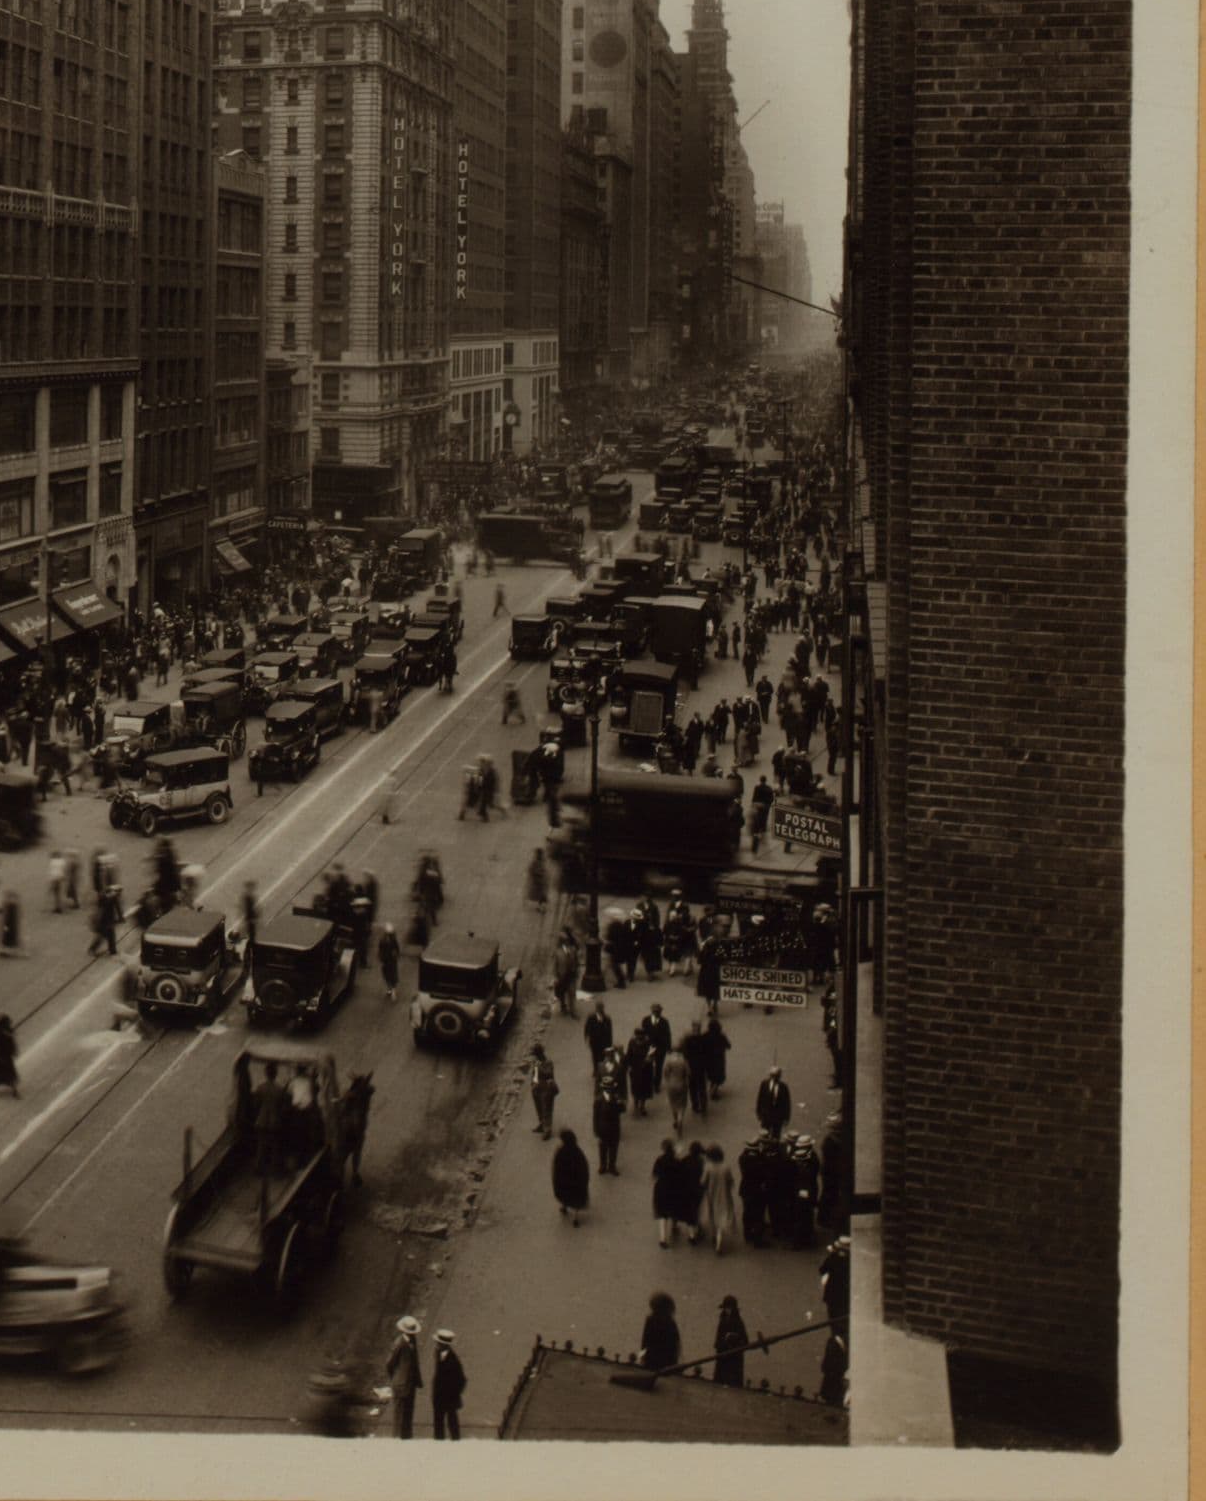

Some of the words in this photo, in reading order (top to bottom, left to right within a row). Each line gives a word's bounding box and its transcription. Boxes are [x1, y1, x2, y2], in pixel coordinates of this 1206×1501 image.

[393, 117, 405, 209] HOTEL
[457, 142, 468, 225] HOTEL
[392, 223, 404, 295] YORK
[456, 235, 467, 300] YORK
[774, 823, 841, 850] TELEGRAPH
[785, 813, 830, 834] POSTAL
[722, 967, 762, 983] SHOES
[723, 987, 752, 1000] HATS
[755, 990, 804, 1005] CLEANED
